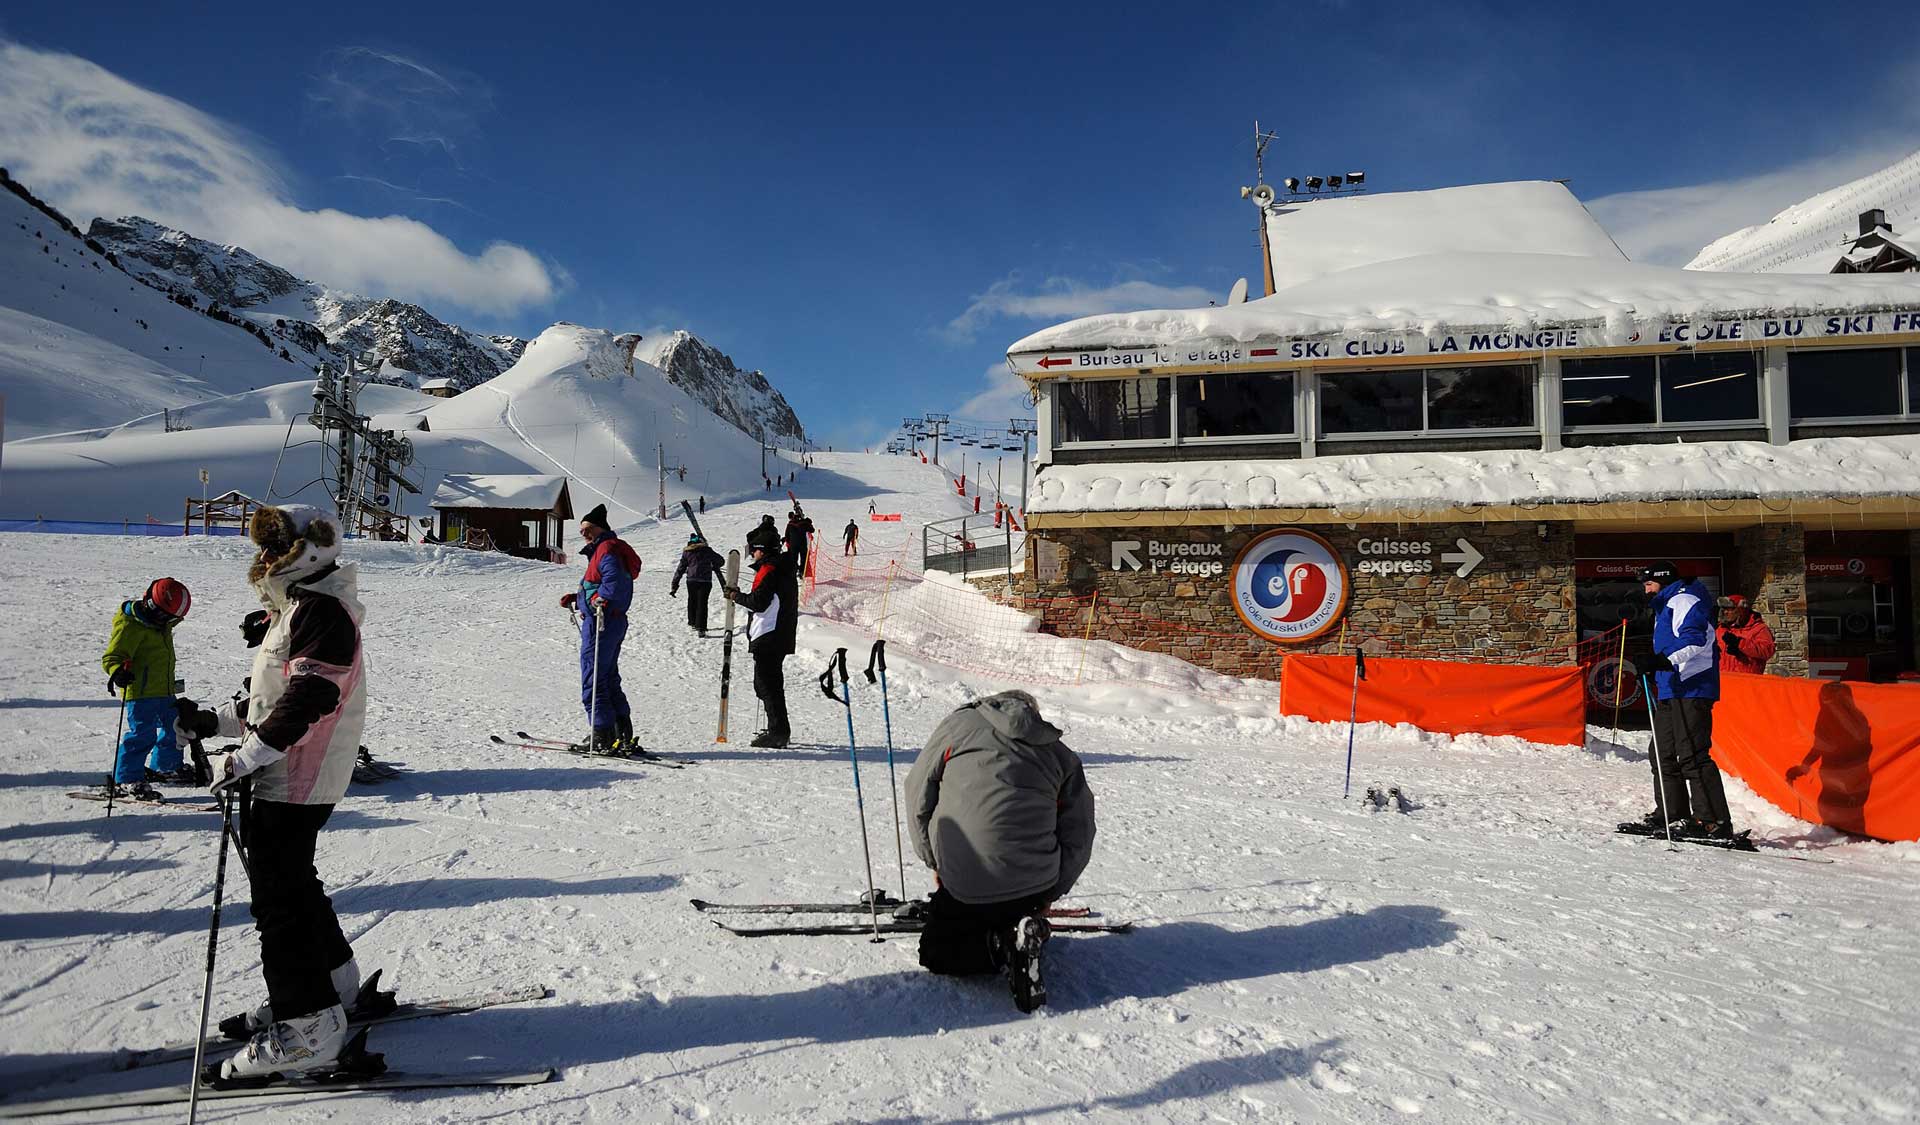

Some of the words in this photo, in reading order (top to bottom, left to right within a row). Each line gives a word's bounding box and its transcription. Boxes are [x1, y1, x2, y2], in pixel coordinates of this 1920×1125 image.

[1658, 322, 1743, 342] ECOLE
[1763, 319, 1804, 337] DU
[1825, 315, 1873, 334] SKI
[1291, 342, 1329, 358] SKI
[1345, 339, 1405, 356] CLUB
[1428, 336, 1458, 353] LA
[1469, 331, 1577, 351] MONGIE
[1079, 352, 1144, 366] Bureau
[1149, 540, 1222, 556] Bureaux
[1358, 537, 1432, 555] Caisses
[1150, 558, 1167, 574] 1er
[1170, 557, 1223, 578] étage
[1358, 559, 1433, 577] express
[1596, 564, 1623, 573] Caisse
[1809, 563, 1845, 573] Express
[1241, 591, 1263, 622] école
[1299, 592, 1336, 631] français
